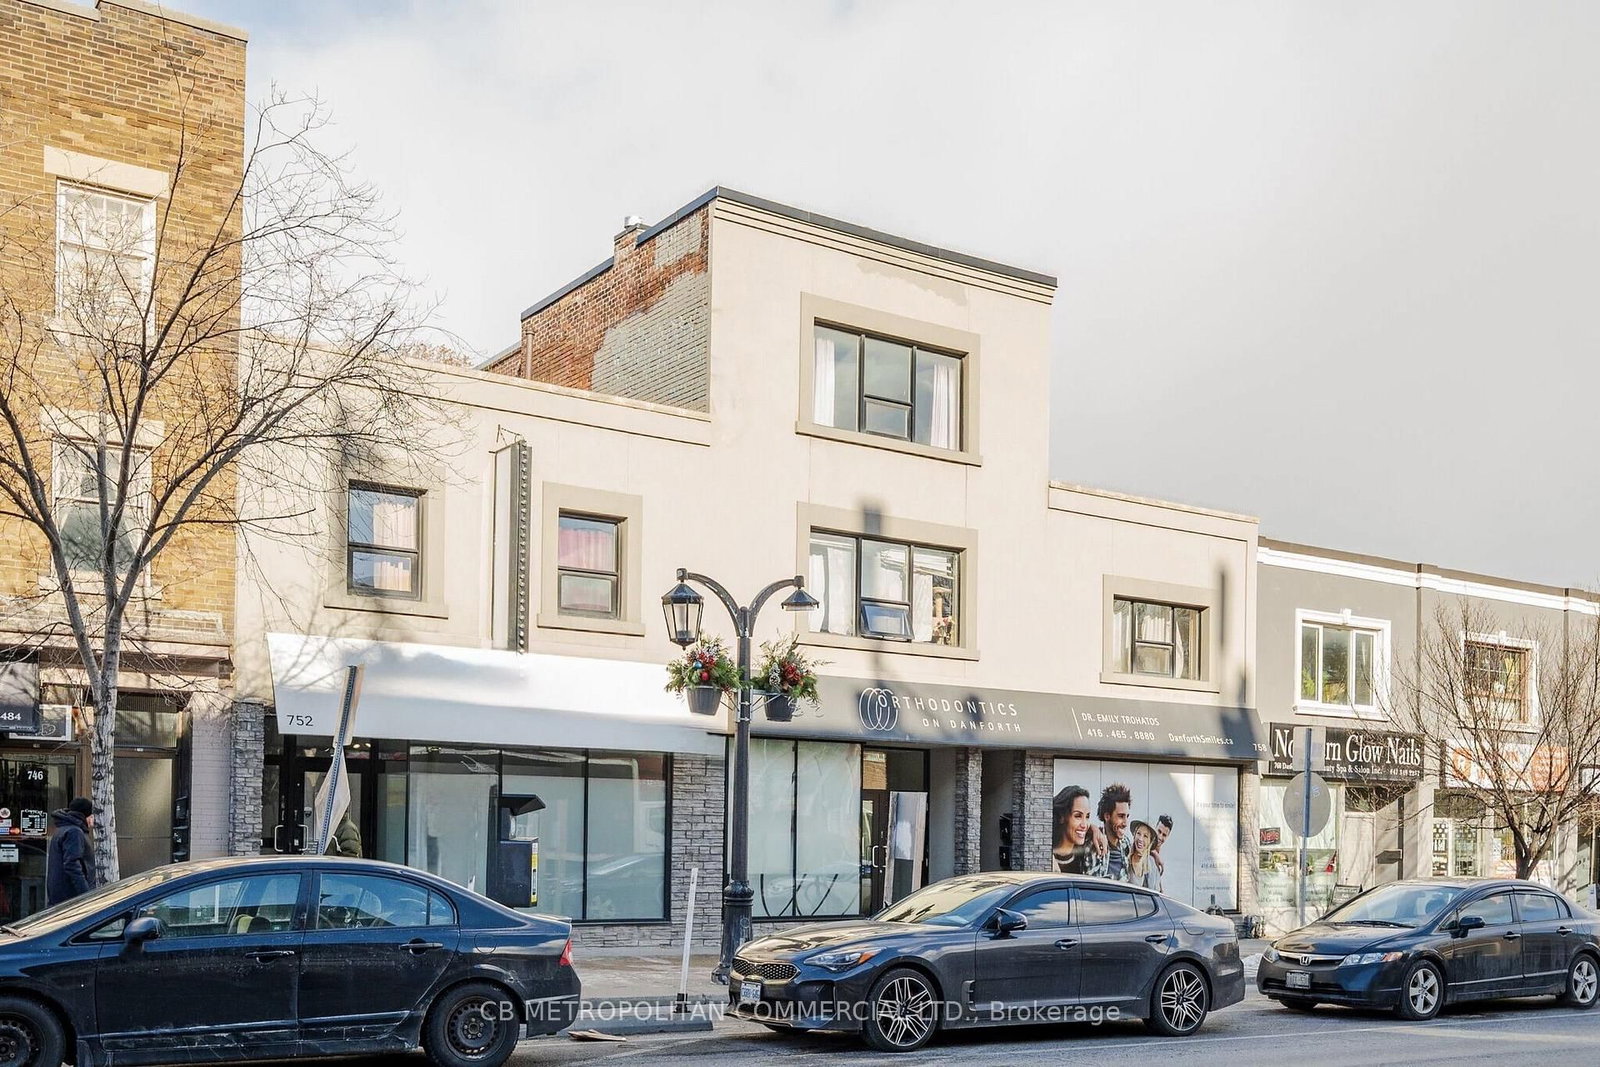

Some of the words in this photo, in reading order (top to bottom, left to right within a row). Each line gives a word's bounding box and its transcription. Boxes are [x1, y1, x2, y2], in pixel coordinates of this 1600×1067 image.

[878, 694, 1018, 716] ORTHODONTICS
[286, 714, 314, 727] 752
[922, 718, 940, 728] ON
[950, 719, 1021, 732] DANFORTH
[1081, 712, 1096, 722] DR.
[1096, 713, 1119, 724] EMILY
[1120, 715, 1160, 726] TROHATOS
[1168, 733, 1234, 745] DanforthSmiles.ca
[1345, 734, 1383, 764] Glow
[1385, 738, 1421, 766] Nails
[27, 770, 44, 781] 746
